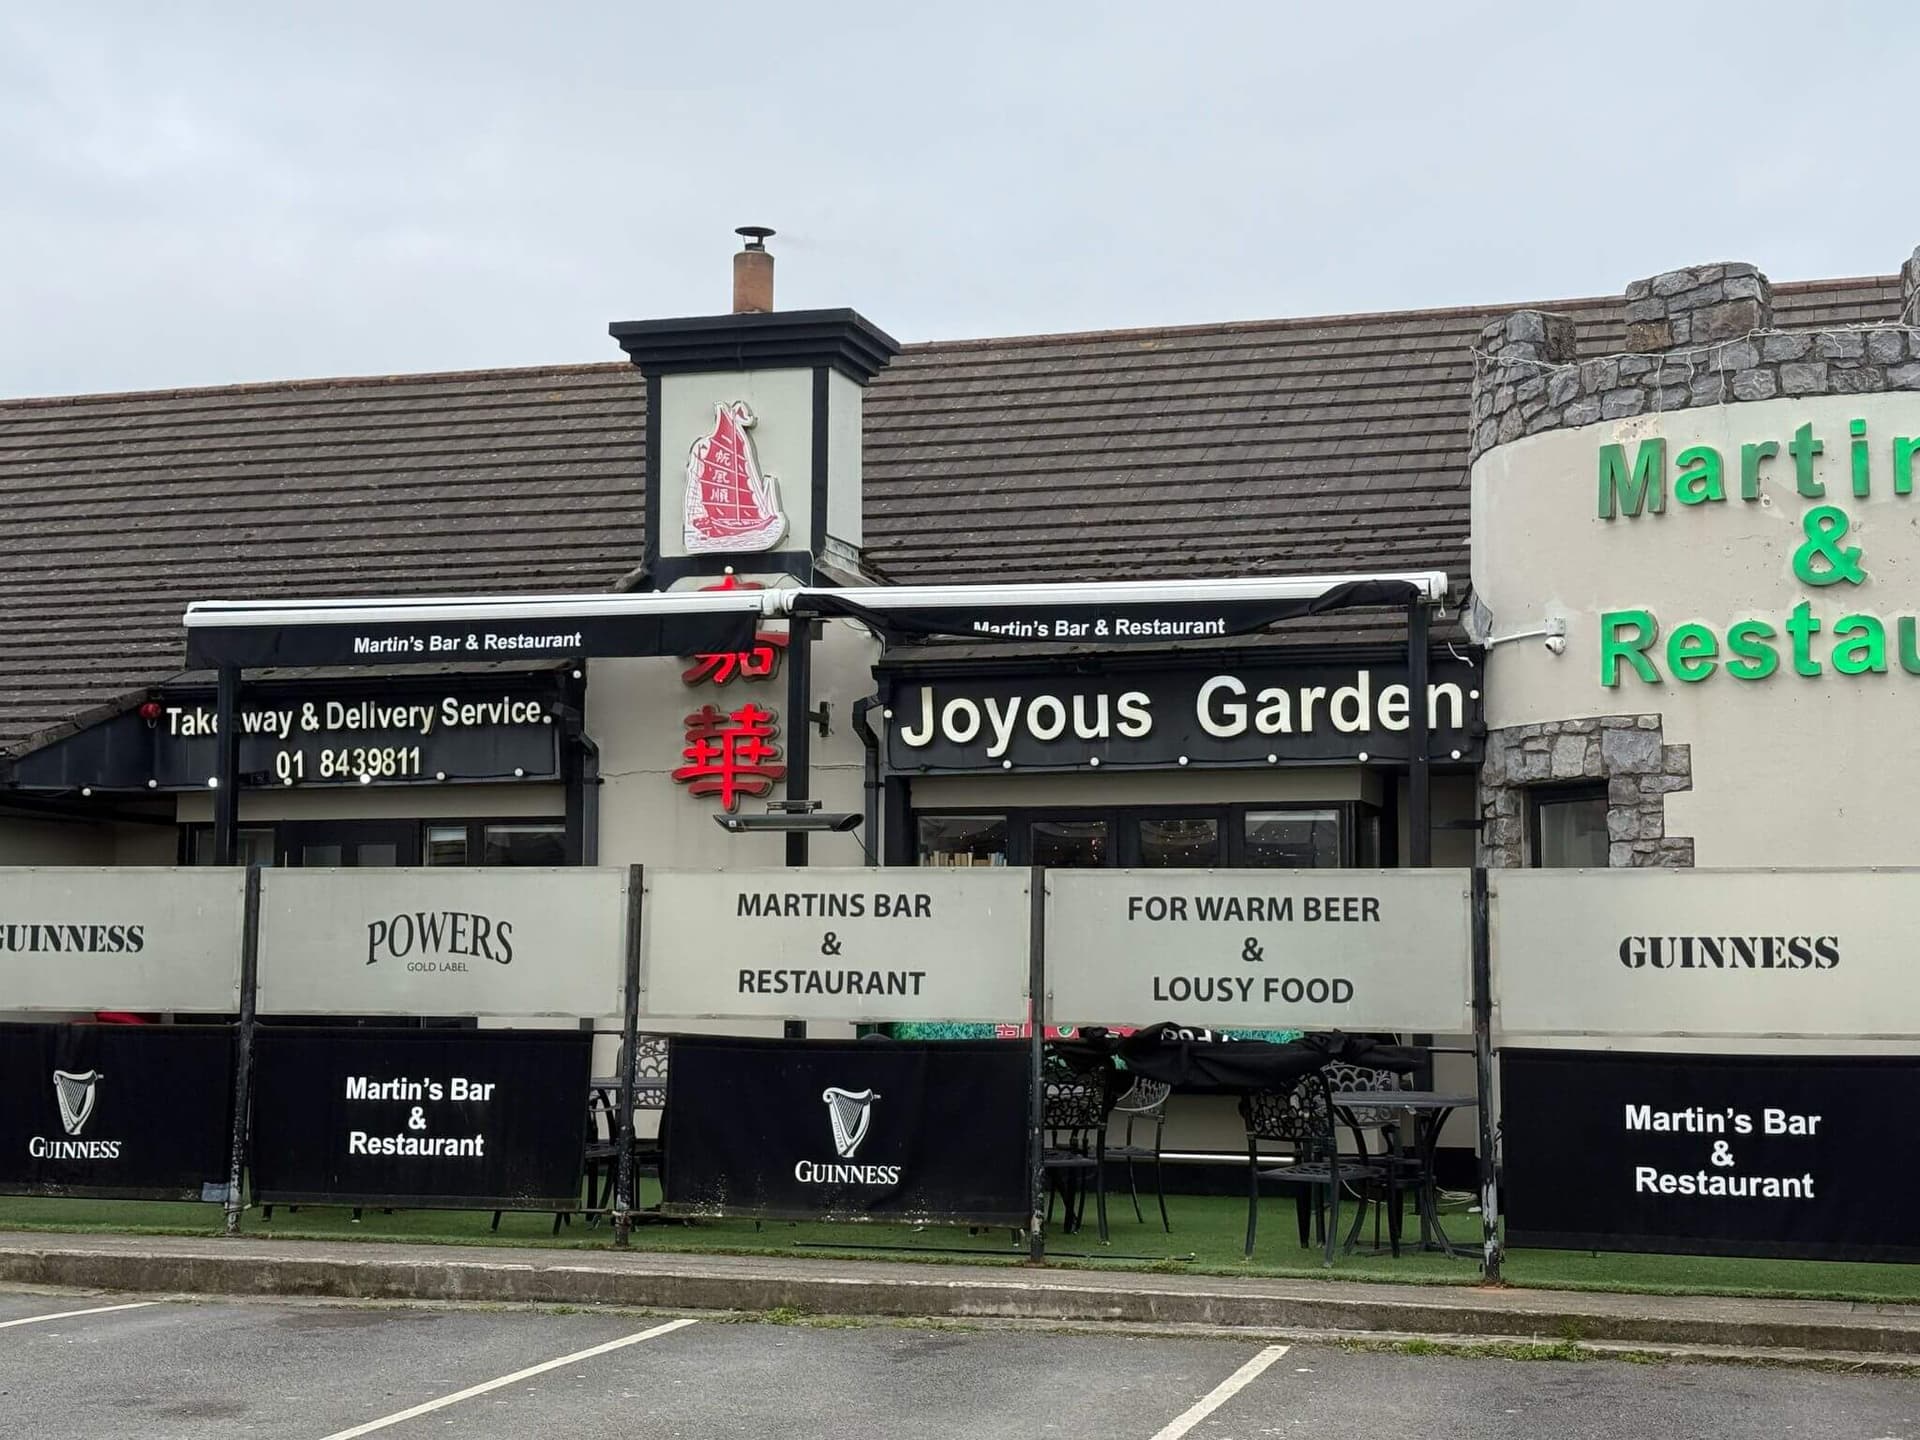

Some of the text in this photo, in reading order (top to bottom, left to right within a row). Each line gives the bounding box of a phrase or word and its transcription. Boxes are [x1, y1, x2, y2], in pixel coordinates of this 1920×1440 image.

[1792, 505, 1867, 587] &
[1054, 620, 1090, 637] Bar
[1094, 619, 1109, 636] &
[1115, 617, 1226, 636] Restaurant
[355, 631, 582, 654] Martin's Bar & Restaurant
[301, 702, 320, 731] &
[326, 700, 434, 735] Delivery
[901, 670, 1464, 758] Joyous Garden
[276, 746, 420, 779] 01 8439811
[737, 893, 932, 918] MARTINS BAR
[1128, 896, 1381, 922] FOR WARM BEER
[0, 924, 144, 953] UINNESS
[367, 911, 514, 966] POWERS
[821, 931, 842, 956] &
[1241, 936, 1264, 962] &
[1619, 936, 1840, 969] GUINNESS
[406, 962, 469, 972] GOLD LABEL
[738, 969, 926, 996] RESTAURANT
[1153, 976, 1354, 1004] LOUSY FOOD
[346, 1075, 496, 1101] Martin's Bar
[408, 1106, 427, 1130] &
[1625, 1104, 1822, 1135] Martin's Bar
[349, 1130, 485, 1157] Restaurant
[1710, 1140, 1735, 1167] &
[1635, 1166, 1815, 1200] Restaurant
